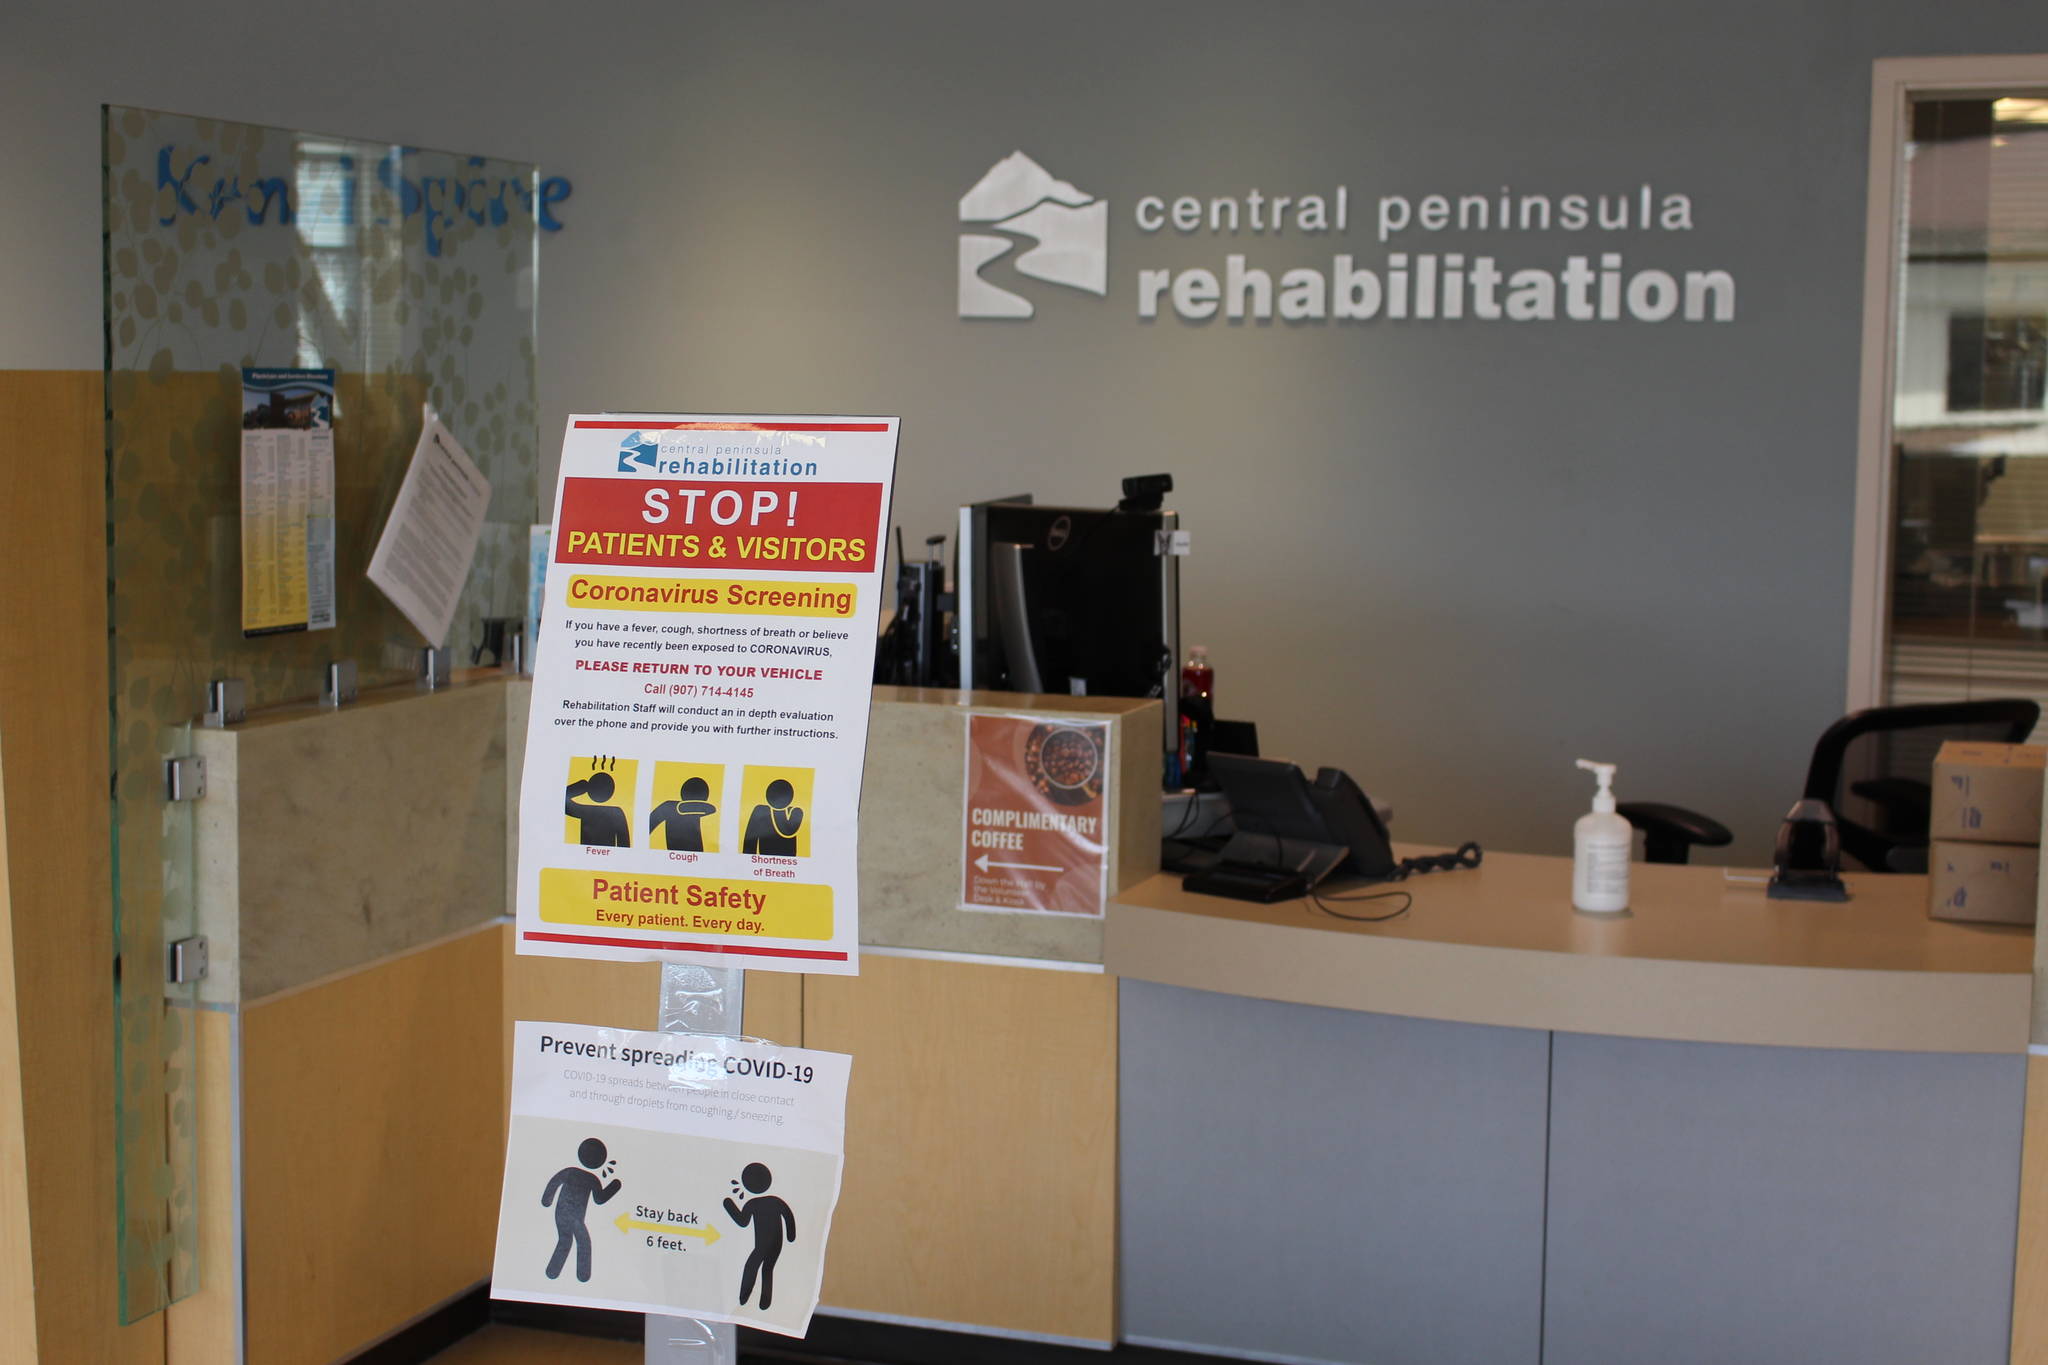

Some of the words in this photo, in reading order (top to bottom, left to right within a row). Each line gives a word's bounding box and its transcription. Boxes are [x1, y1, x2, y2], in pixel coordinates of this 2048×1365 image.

[158, 145, 355, 227] Kni
[1136, 186, 1347, 232] central
[1379, 184, 1693, 242] peninsula
[1138, 254, 1736, 322] rehabilitation
[661, 444, 708, 455] central
[715, 445, 782, 457] peninsula
[659, 458, 818, 476] rehabilitation
[642, 489, 799, 527] STOP!
[568, 532, 700, 558] PATIENTS
[709, 537, 727, 558] &
[737, 536, 866, 562] VISITORS
[571, 579, 718, 604] Coronavirus
[728, 584, 852, 615] Screening
[565, 620, 573, 630] If
[574, 623, 594, 633] you
[596, 622, 619, 632] have
[623, 624, 629, 632] a
[631, 623, 658, 634] fever,
[661, 624, 695, 636] cough,
[698, 624, 747, 637] shortness
[751, 626, 761, 637] of
[763, 627, 796, 638] breath
[799, 630, 810, 639] or
[813, 629, 849, 640] believe
[575, 640, 594, 651] you
[596, 639, 620, 649] have
[623, 640, 663, 653] recently
[666, 642, 689, 652] been
[692, 643, 735, 656] exposed
[738, 644, 747, 653] to
[576, 660, 628, 673] PLEASE
[633, 662, 690, 675] RETURN
[695, 664, 713, 676] TO
[718, 665, 756, 678] YOUR
[760, 668, 823, 681] VEHICLE
[644, 683, 666, 695] Call
[669, 684, 698, 698] (907)
[701, 685, 754, 698] 714-4145
[562, 700, 630, 713] Rehabilitation
[633, 703, 656, 713] Staff
[659, 704, 675, 714] will
[677, 705, 719, 716] conduct
[736, 708, 746, 717] in
[748, 708, 777, 720] depth
[780, 710, 834, 722] evaluation
[554, 719, 575, 727] over
[578, 718, 594, 728] the
[596, 719, 628, 730] phone
[630, 720, 649, 730] and
[651, 721, 689, 734] provide
[691, 725, 710, 734] you
[713, 723, 734, 734] with
[737, 725, 771, 736] further
[774, 727, 839, 740] instructions.
[972, 808, 1097, 834] COMPLIMENTARY
[972, 830, 1024, 850] COFFEE
[586, 847, 611, 857] Fever
[669, 852, 699, 864] Cough
[751, 855, 798, 866] Shortness
[754, 867, 763, 877] of
[765, 868, 796, 879] Breath
[593, 878, 679, 906] Patient
[686, 885, 767, 914] Safety
[596, 910, 634, 927] Every
[638, 912, 689, 929] patient.
[693, 915, 732, 933] Every
[737, 919, 765, 933] day.
[540, 1035, 617, 1061] Prevent
[724, 1056, 814, 1084] COVID-19
[563, 1069, 606, 1084] COVID-19
[608, 1074, 644, 1090] spreads
[722, 1088, 729, 1098] in
[732, 1089, 756, 1103] close
[758, 1093, 794, 1107] contact
[570, 1089, 587, 1101] and
[589, 1091, 625, 1106] through
[627, 1094, 665, 1111] droplets
[666, 1098, 688, 1112] from
[636, 1205, 665, 1221] Stay
[668, 1209, 698, 1225] back
[646, 1236, 654, 1248] 6
[657, 1237, 687, 1252] feet.
